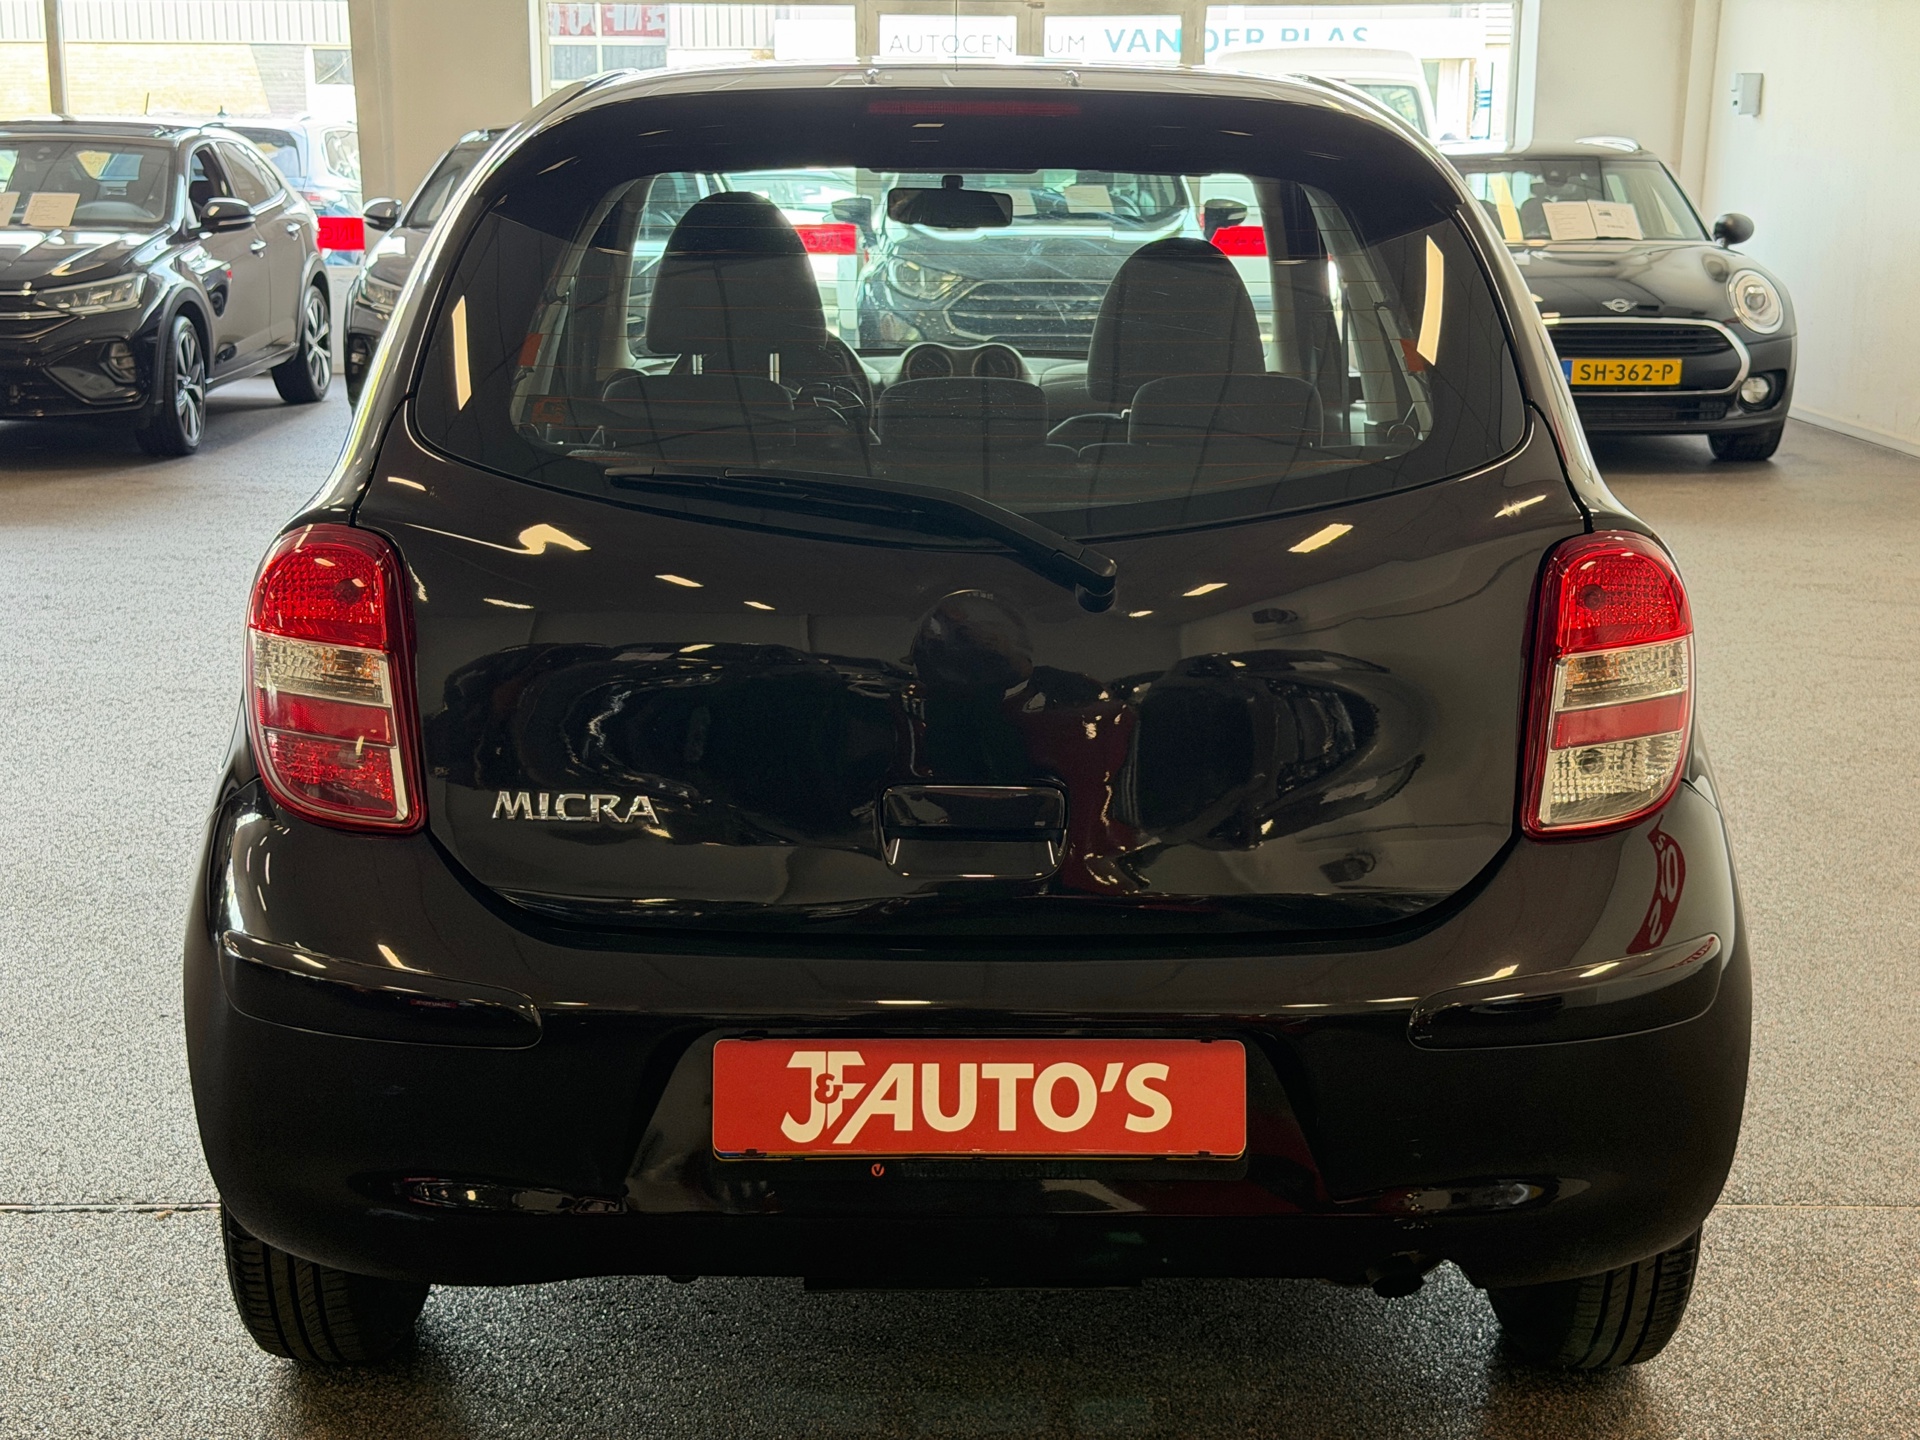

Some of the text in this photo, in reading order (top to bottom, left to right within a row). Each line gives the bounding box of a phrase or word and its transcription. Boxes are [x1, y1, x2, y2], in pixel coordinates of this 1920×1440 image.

[889, 34, 1085, 53] AUTOCENUM
[1104, 28, 1182, 53] VAN
[1580, 364, 1674, 381] SH-362-P
[492, 790, 659, 824] MICRA
[832, 1062, 1173, 1144] AUTO'S
